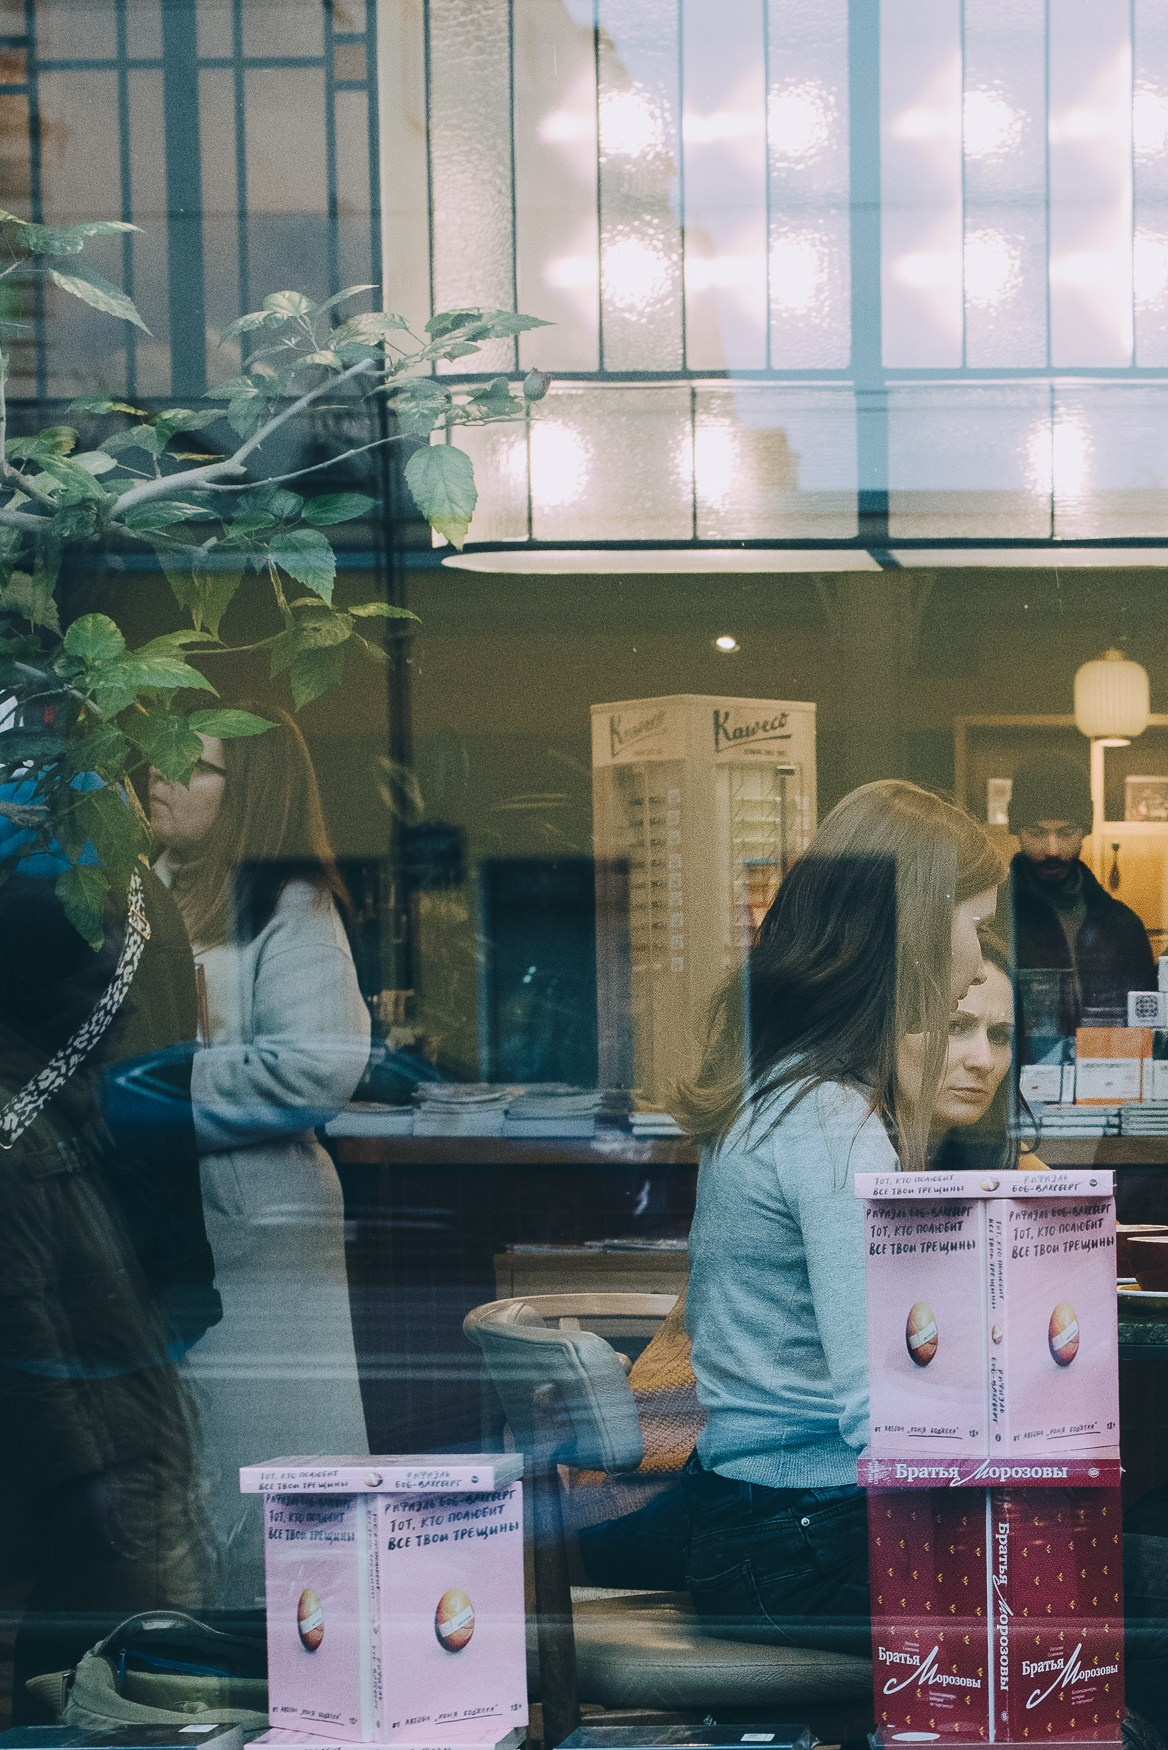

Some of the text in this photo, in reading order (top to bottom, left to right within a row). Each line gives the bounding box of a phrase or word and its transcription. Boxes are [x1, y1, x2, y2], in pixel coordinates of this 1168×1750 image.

[713, 709, 791, 753] Kaweco
[895, 1464, 959, 1481] Братья
[950, 1459, 1067, 1486] Морозовы
[388, 1522, 519, 1550] ВСЕ ТВОИ ТРЕЩИНЫ
[390, 1505, 506, 1533] ТОТ, КТО ПОЛЮБИТ
[993, 1522, 1013, 1690] Братья Морозовы
[878, 1645, 981, 1695] Братья Морозовы
[1022, 1658, 1064, 1678] Братья
[1026, 1642, 1118, 1709] Морозовы
